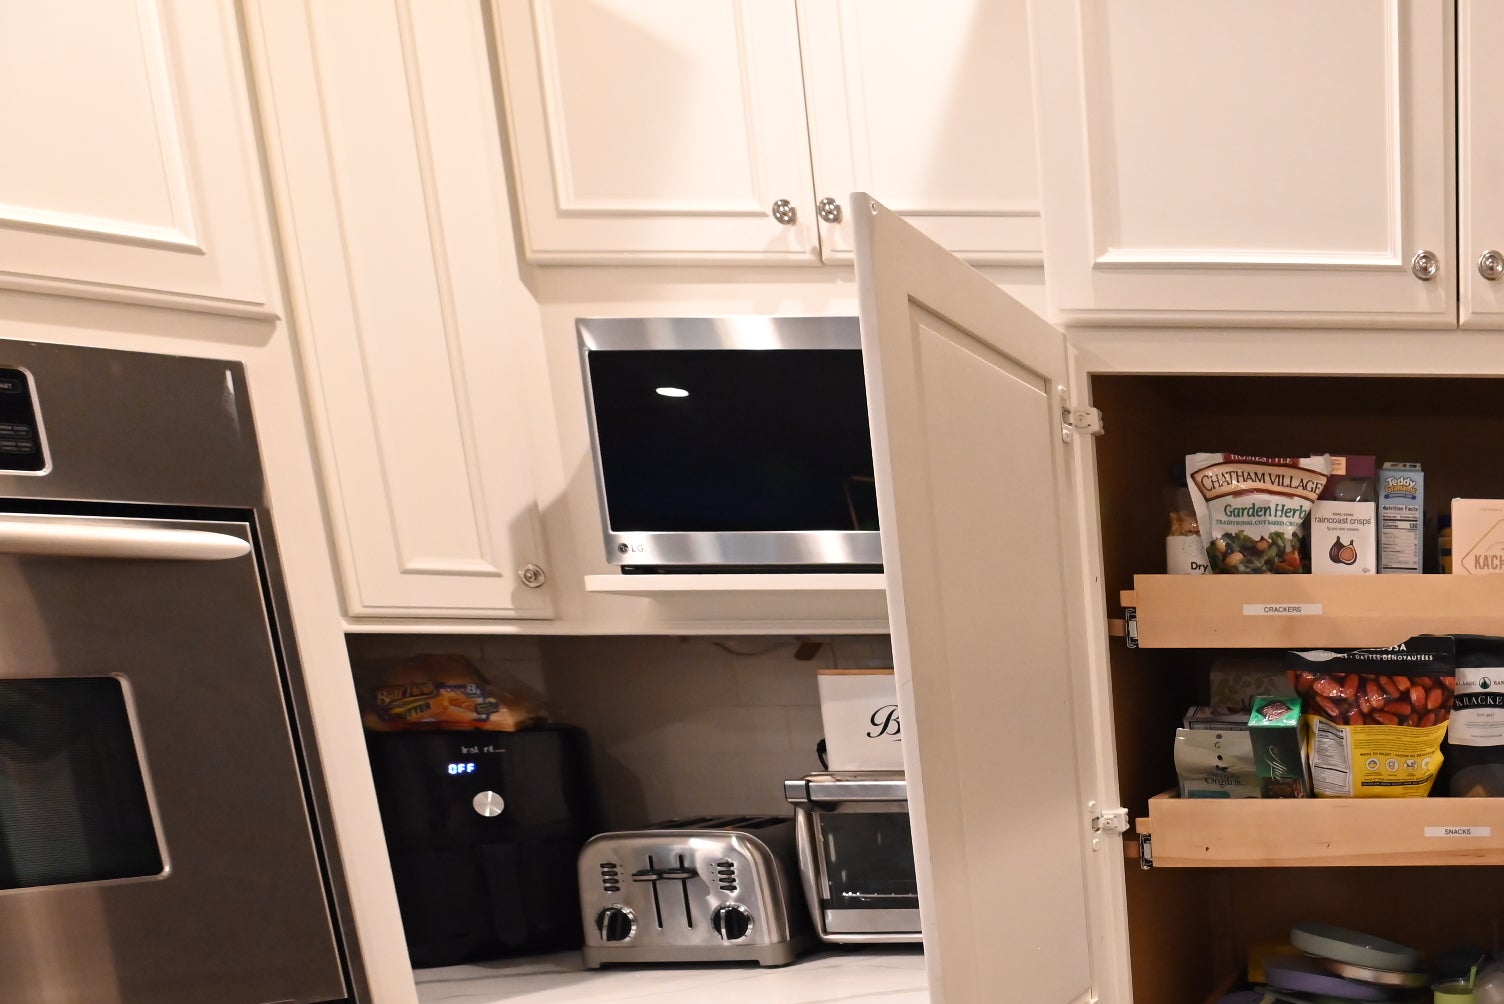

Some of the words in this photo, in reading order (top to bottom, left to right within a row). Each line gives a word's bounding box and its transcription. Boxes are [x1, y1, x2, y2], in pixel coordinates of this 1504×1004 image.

[1200, 470, 1266, 492] CHATHAM
[1267, 472, 1323, 496] VILLAGE
[1386, 476, 1416, 487] Teddy
[1223, 502, 1272, 518] Garden
[1273, 503, 1308, 520] Herb
[1314, 516, 1349, 525] raincoast
[1349, 517, 1372, 527] crisps
[631, 544, 644, 553] LG
[1190, 561, 1209, 573] Dry
[1382, 654, 1433, 662] DÉNOYAUTÉES
[448, 763, 475, 775] OFF
